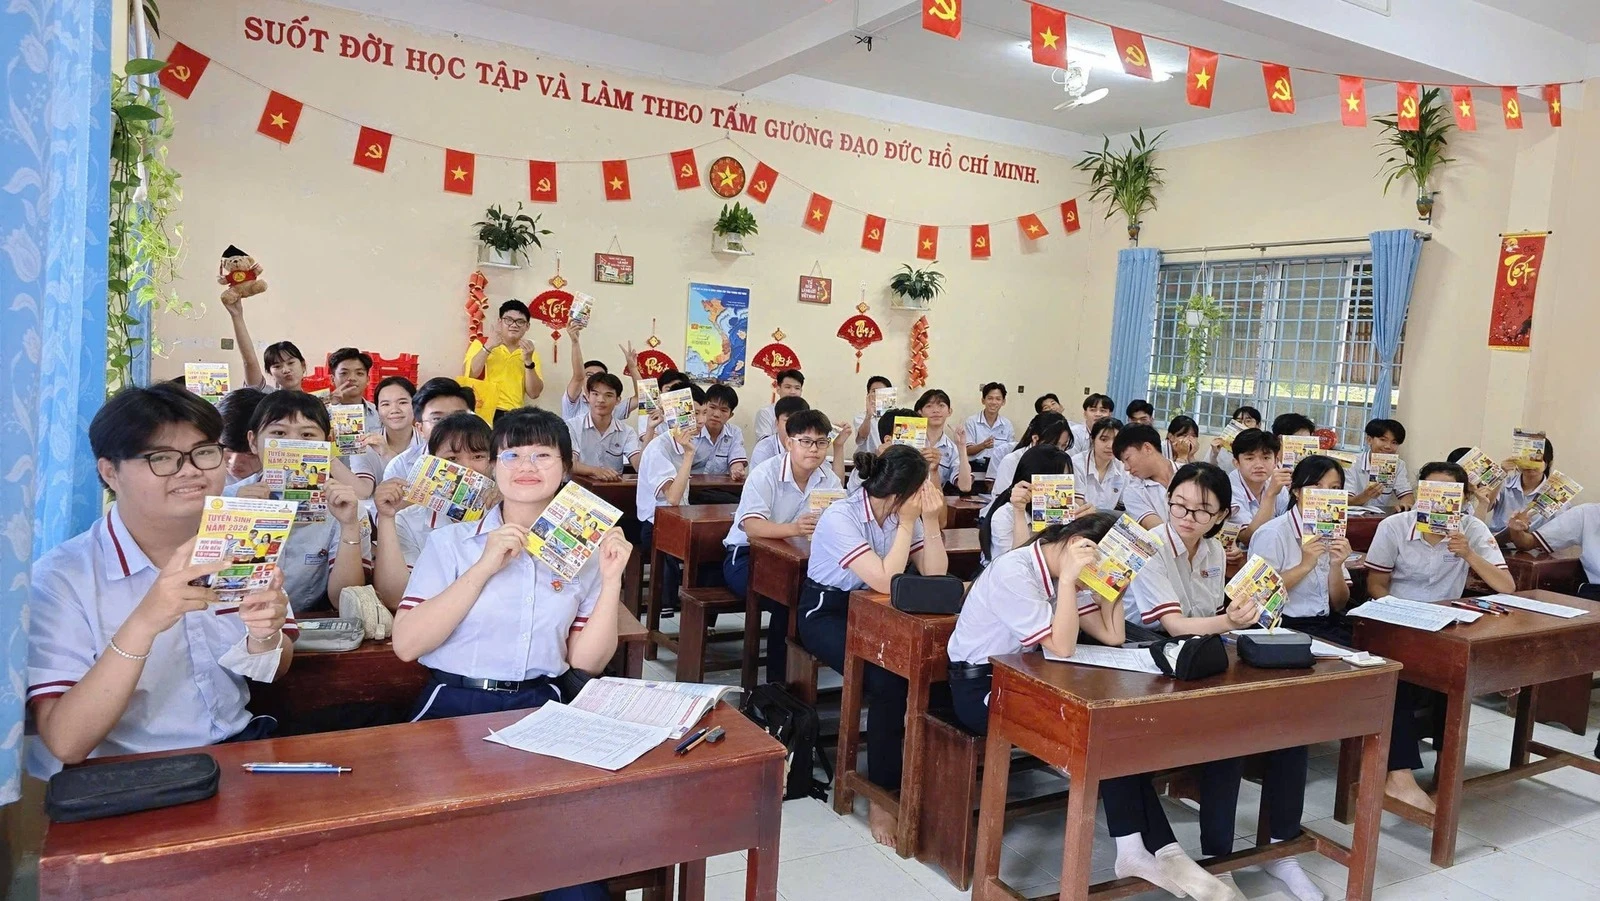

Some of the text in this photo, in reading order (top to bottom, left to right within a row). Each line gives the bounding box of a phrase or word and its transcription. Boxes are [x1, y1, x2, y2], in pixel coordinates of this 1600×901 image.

[244, 16, 1040, 184] SUỐT ĐỜI HỌC TẬP VÀ LÀM THEO TẤM GƯƠNG ĐẠO ĐỨC HỒ CHÍ MINH.
[1504, 254, 1536, 287] Tết
[208, 512, 231, 522] TUYỂN
[205, 524, 226, 532] NĂM
